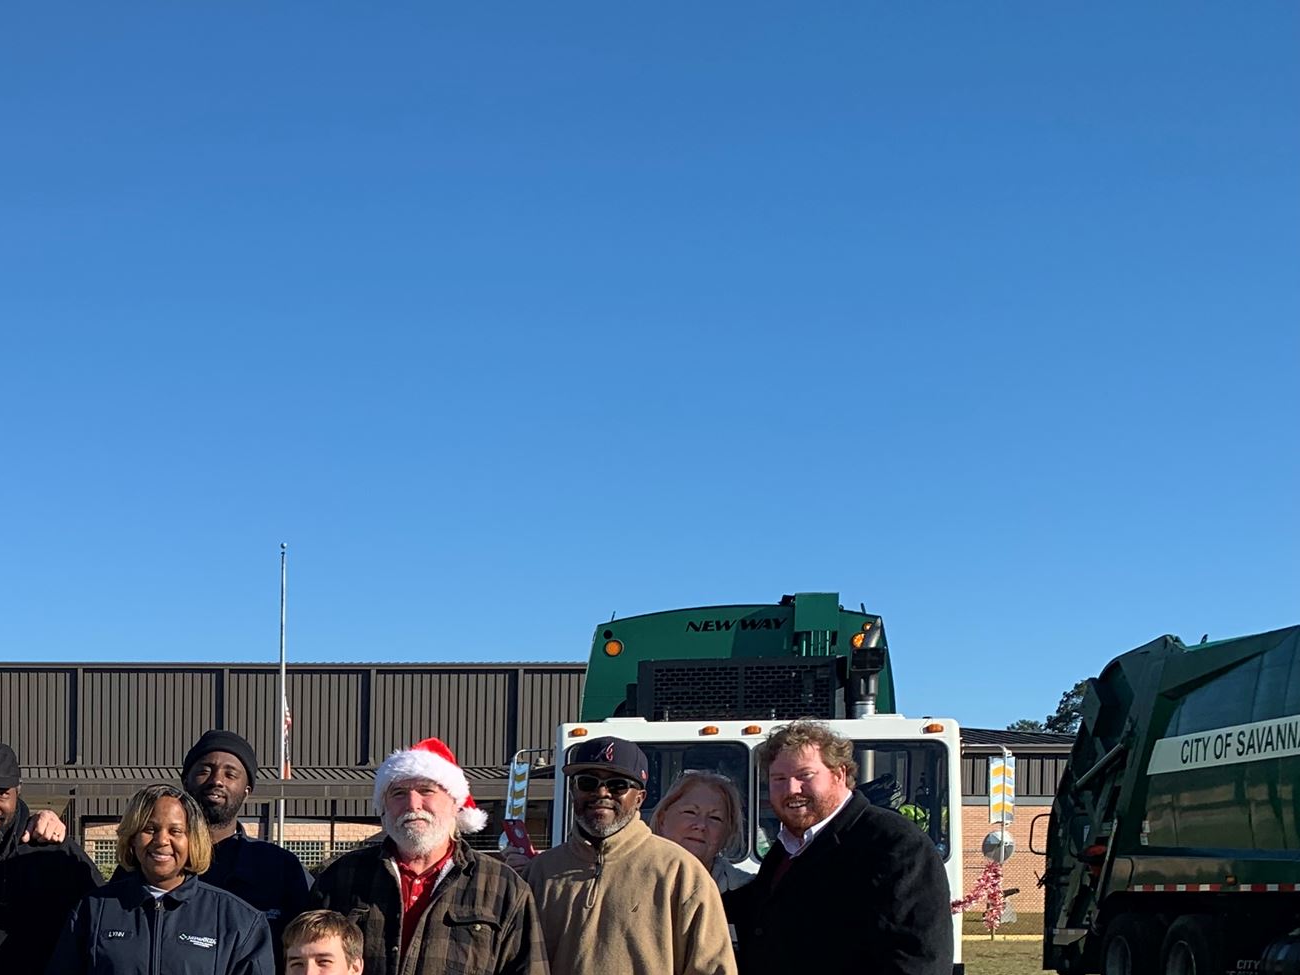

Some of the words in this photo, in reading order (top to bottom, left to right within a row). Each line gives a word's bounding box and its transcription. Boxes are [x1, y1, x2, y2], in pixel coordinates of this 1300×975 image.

[686, 620, 737, 632] NEW
[740, 618, 788, 631] WAY
[1181, 736, 1211, 764] CITY
[1214, 732, 1233, 760] OF
[1236, 722, 1300, 756] SAVANN
[1236, 960, 1260, 969] CITY
